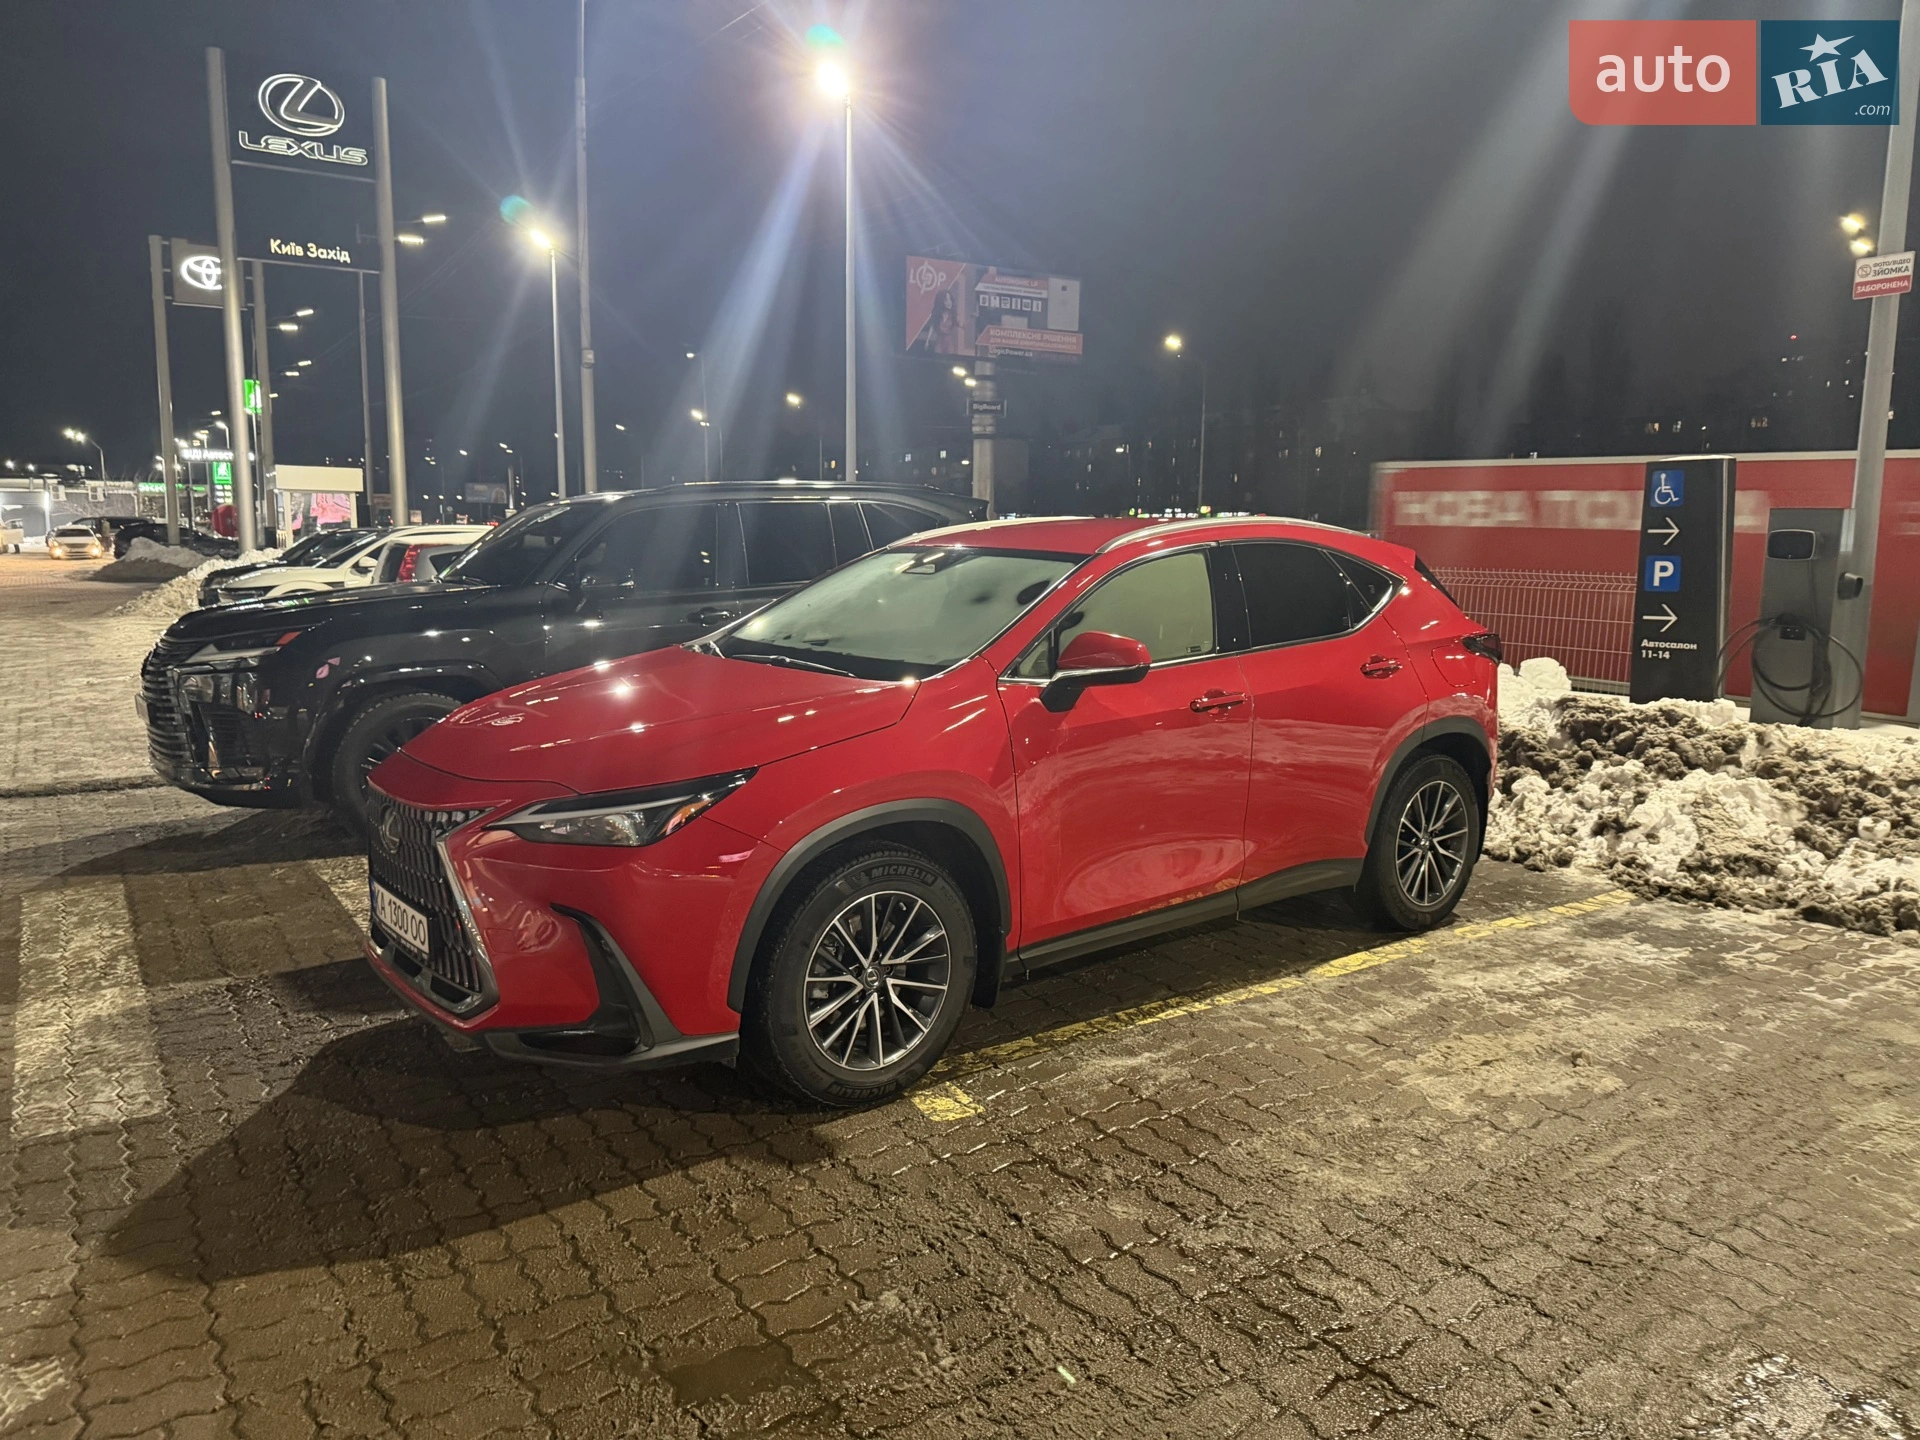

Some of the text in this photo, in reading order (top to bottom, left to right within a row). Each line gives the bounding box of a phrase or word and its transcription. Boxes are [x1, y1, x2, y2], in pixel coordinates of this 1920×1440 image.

[238, 131, 368, 166] LEXUS
[270, 238, 351, 264] Київ Захід
[1872, 265, 1910, 277] ЗЙОМКА
[1855, 280, 1909, 294] ЗАБОРОНЕНА
[989, 328, 1042, 340] КОМПЛЕКСНЕ
[1653, 561, 1675, 587] P
[1641, 638, 1698, 650] Автосалон
[1641, 650, 1671, 660] 11-14
[871, 864, 936, 886] MICHELIN
[387, 898, 409, 935] 1300
